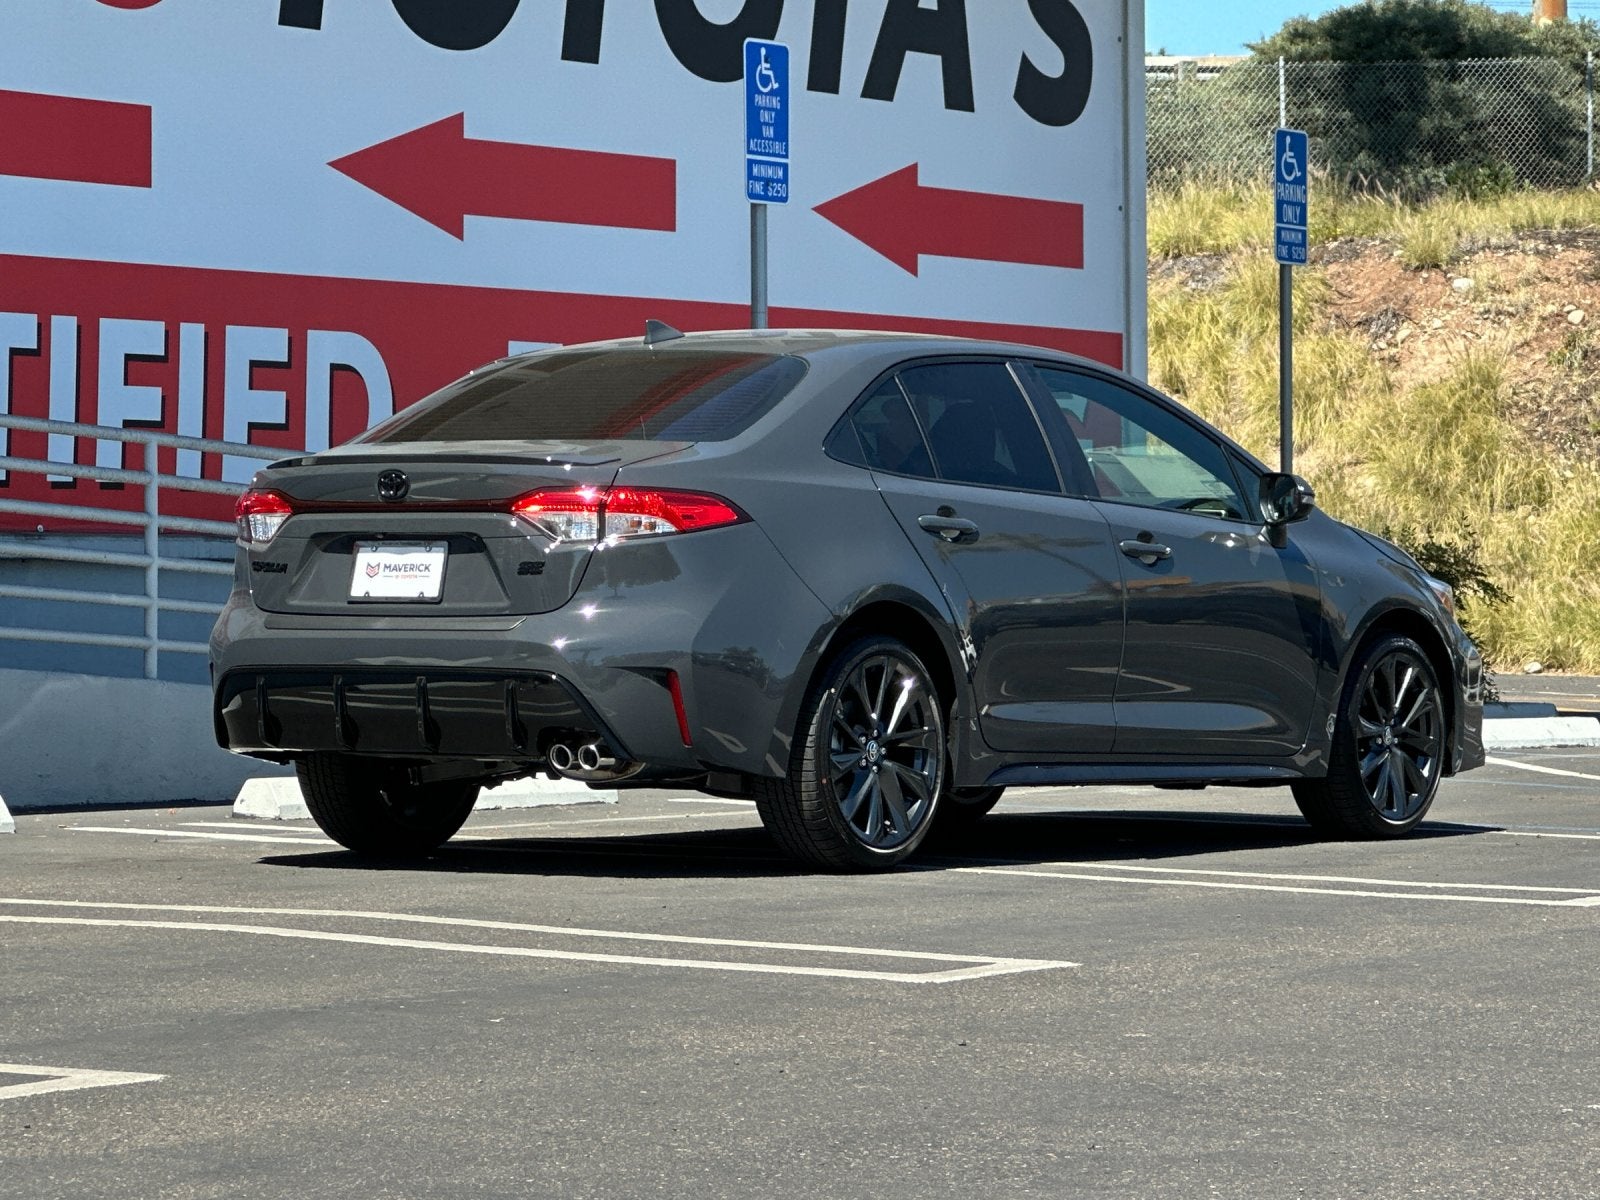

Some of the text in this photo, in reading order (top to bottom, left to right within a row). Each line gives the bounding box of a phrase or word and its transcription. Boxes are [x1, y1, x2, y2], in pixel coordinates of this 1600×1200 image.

[754, 94, 781, 109] PARKING
[760, 109, 776, 123] ONLY
[762, 125, 774, 138] VAN
[749, 138, 786, 155] ACCESSIBLE
[752, 163, 784, 179] MINIMUM
[749, 180, 787, 198] FINE $250
[1277, 182, 1306, 203] PARKING
[1282, 204, 1301, 224] ONLY
[383, 563, 432, 573] MAVERICK
